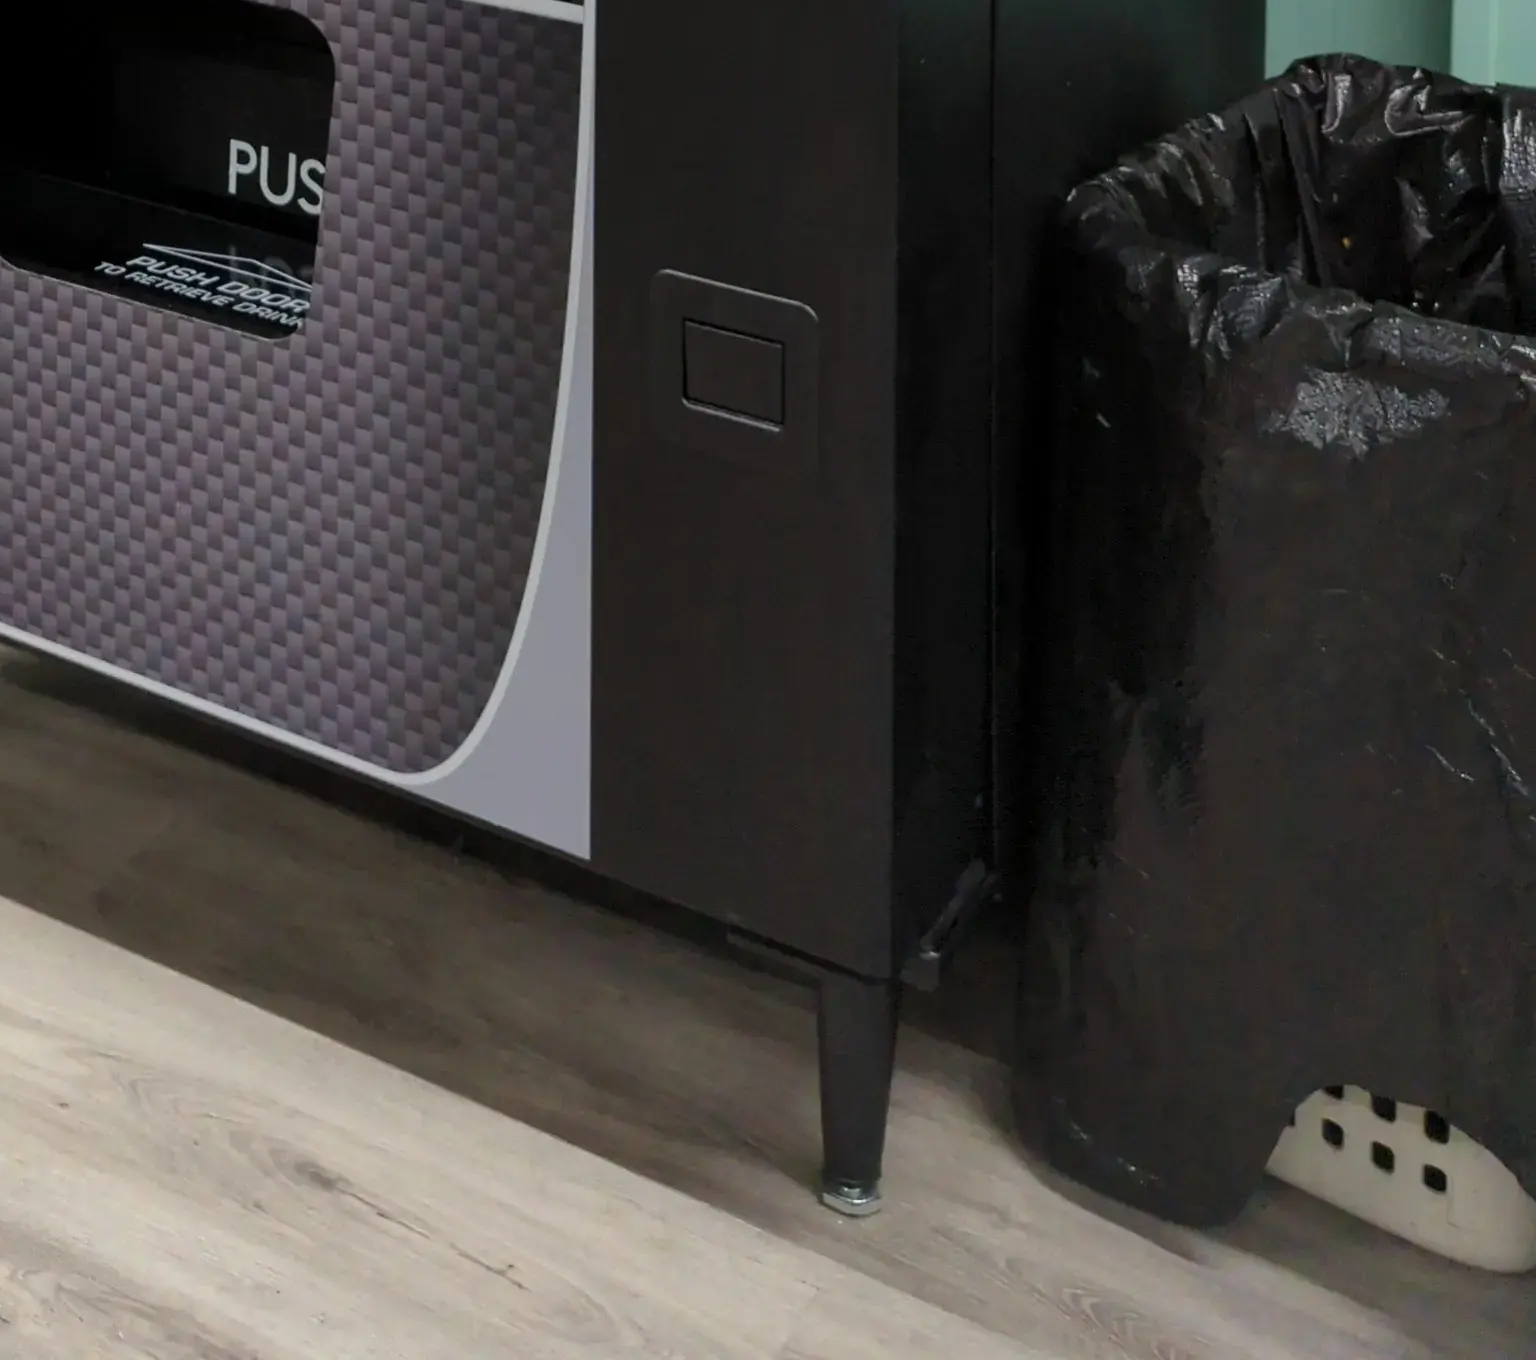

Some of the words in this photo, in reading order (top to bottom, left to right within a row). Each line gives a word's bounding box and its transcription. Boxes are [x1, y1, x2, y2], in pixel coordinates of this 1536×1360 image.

[227, 137, 327, 217] PUS
[94, 261, 126, 276] TO
[124, 270, 235, 307] RETRIEVE
[125, 255, 220, 287] PUSH
[216, 281, 311, 313] DOOR
